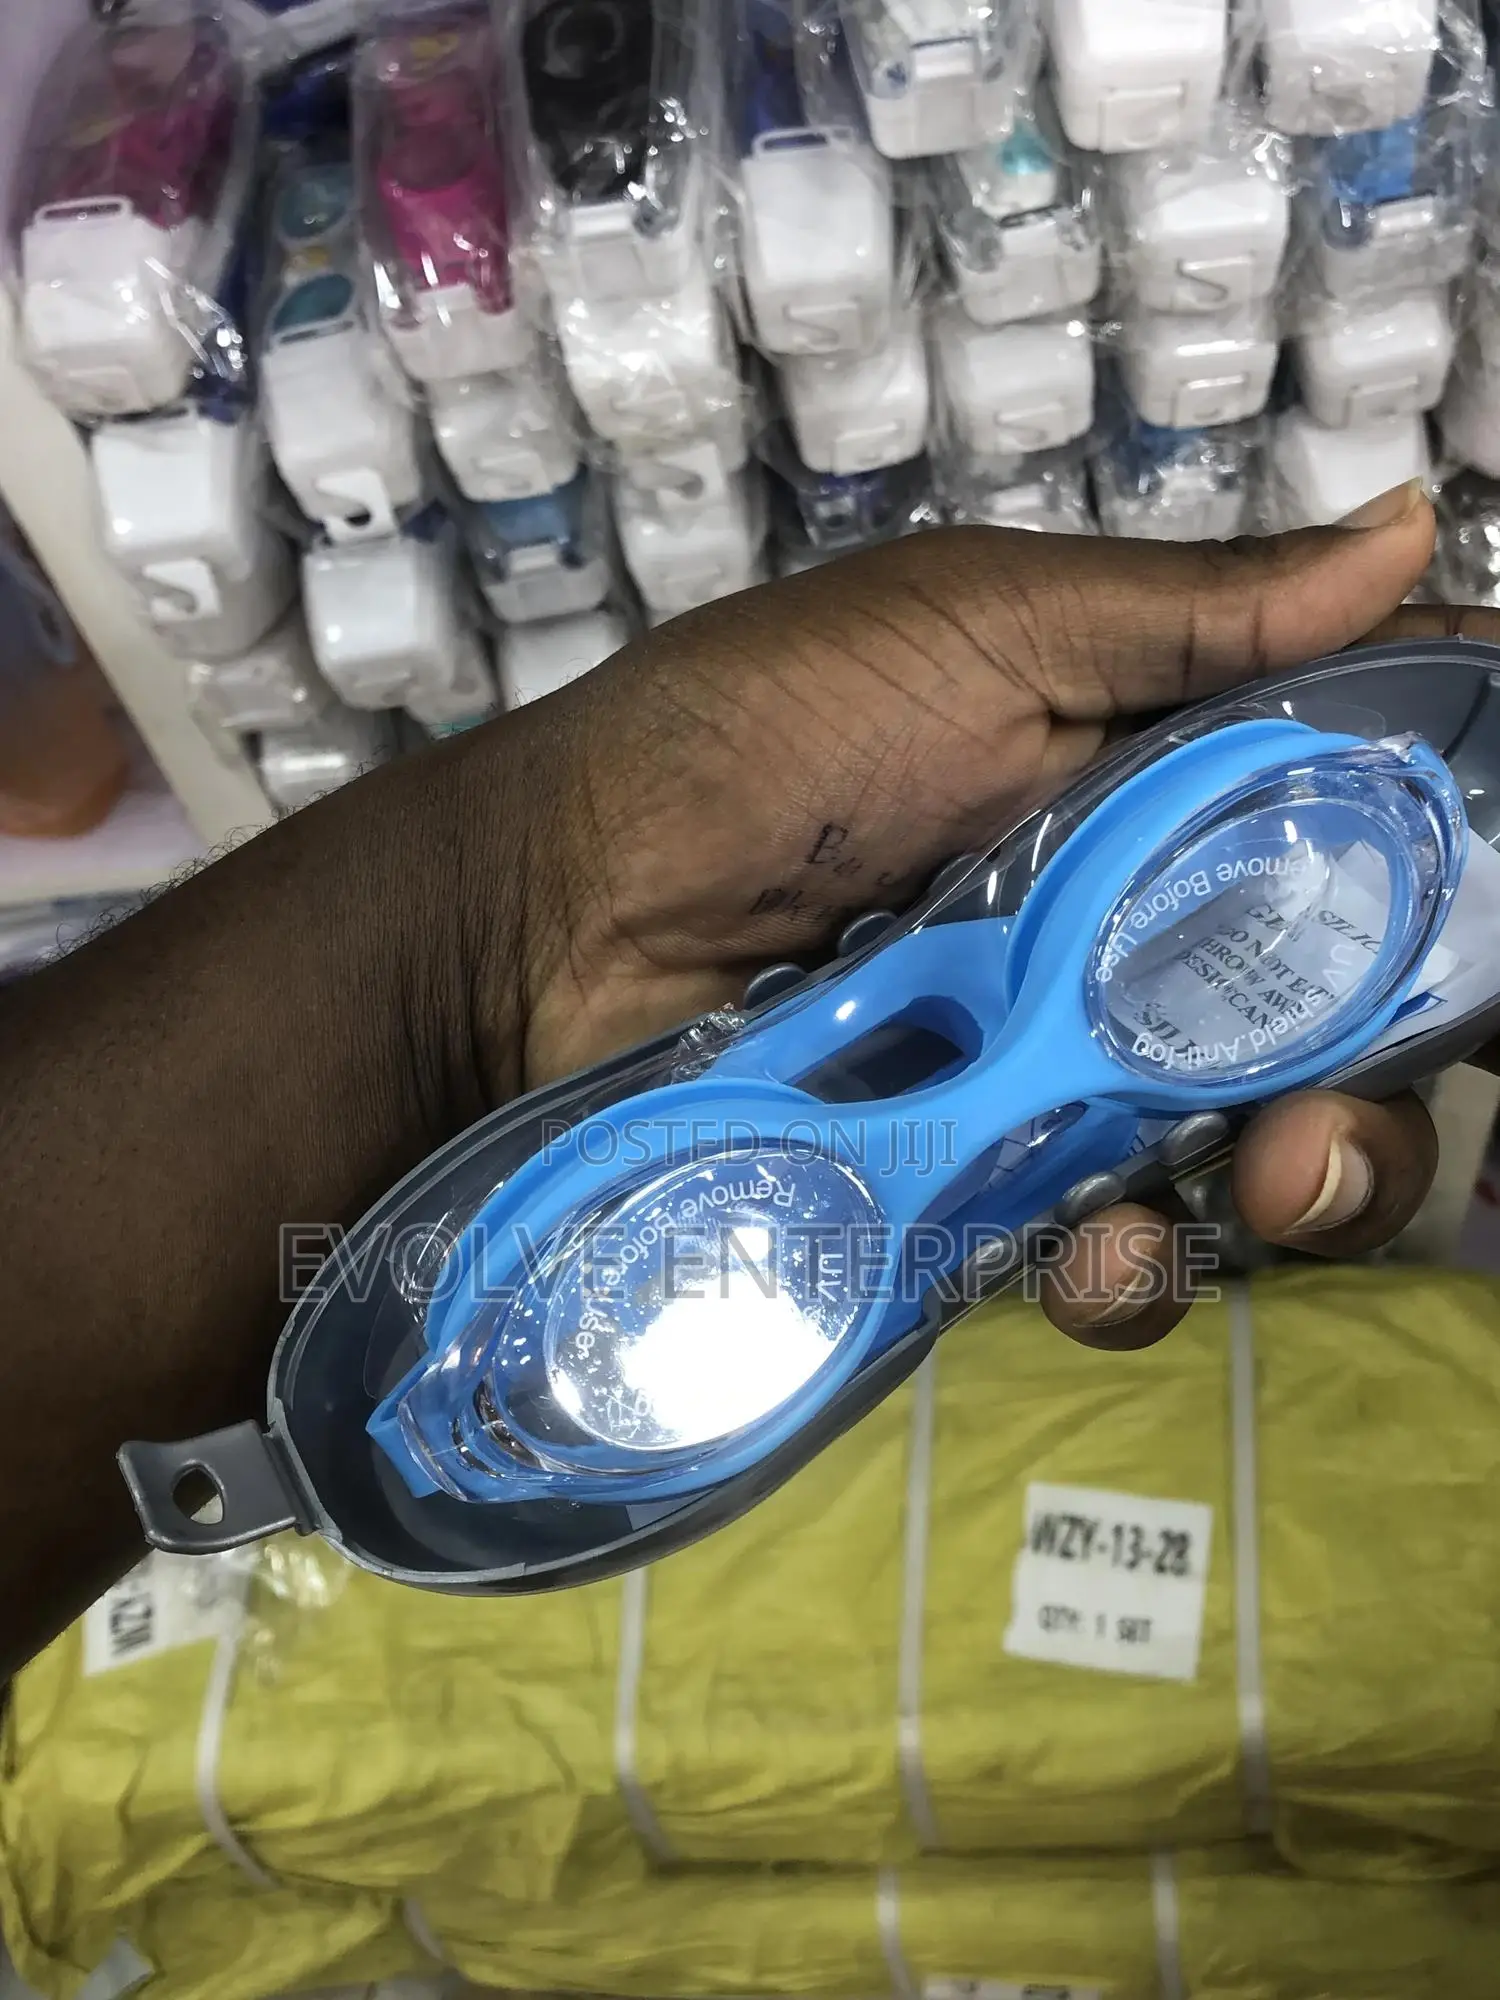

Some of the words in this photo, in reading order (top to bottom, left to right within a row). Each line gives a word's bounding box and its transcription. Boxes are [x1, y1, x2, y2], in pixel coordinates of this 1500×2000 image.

[1215, 854, 1317, 882] emove
[1129, 870, 1212, 929] Bofore
[1095, 932, 1138, 983] Use
[1322, 943, 1357, 991] UV
[679, 1177, 798, 1219] Remove
